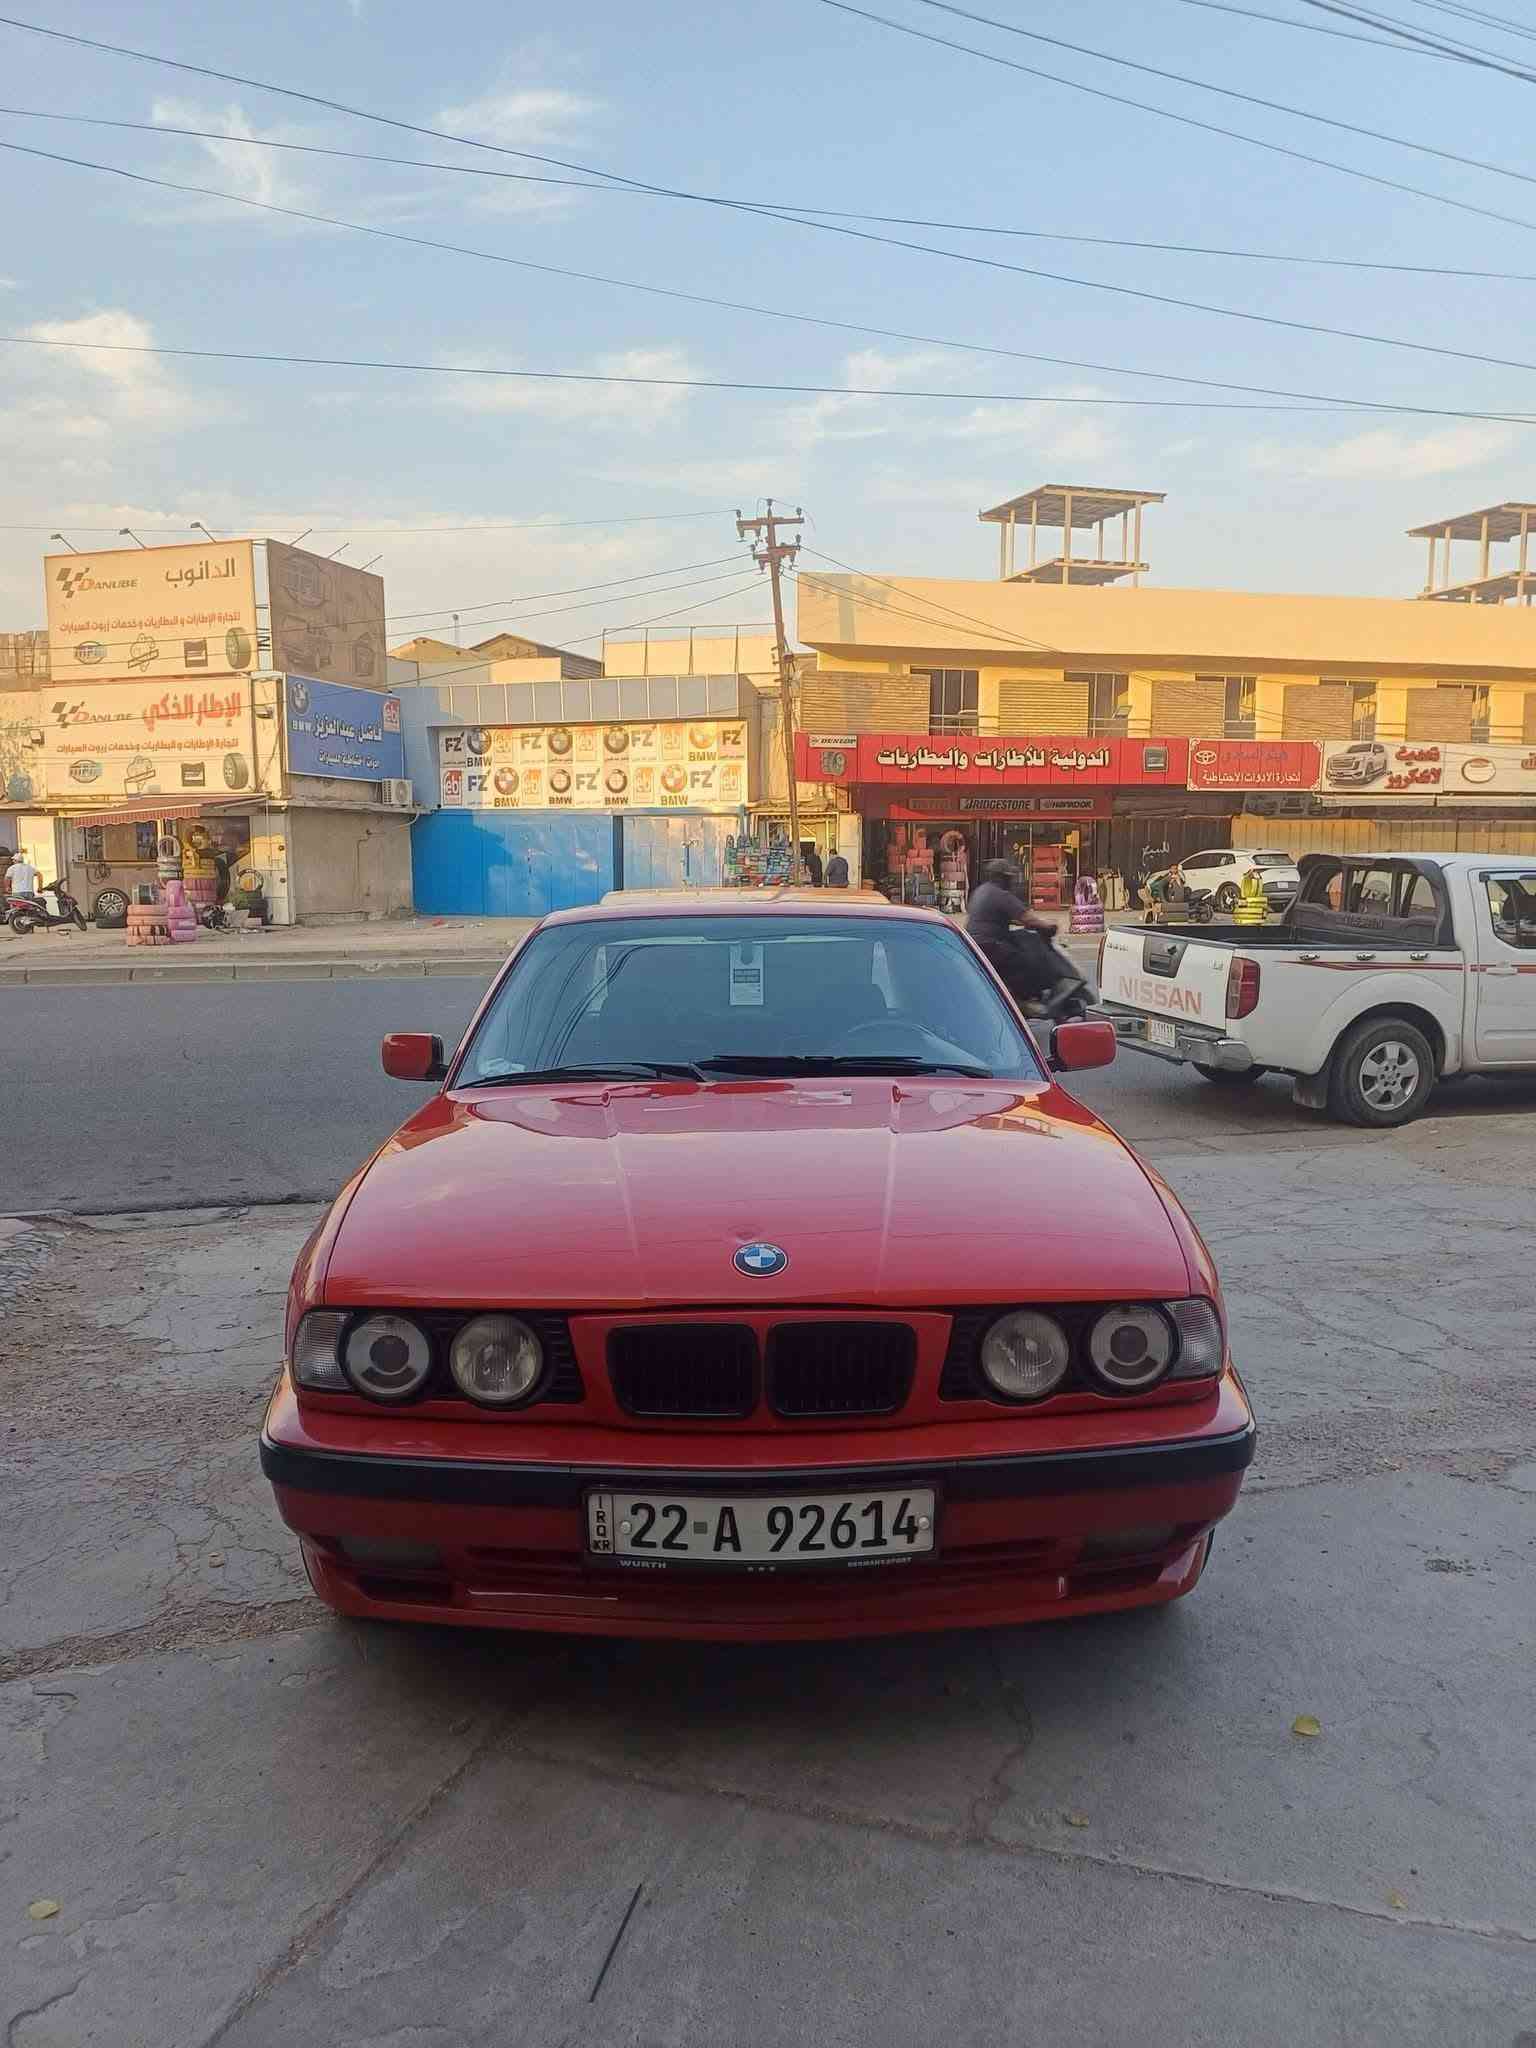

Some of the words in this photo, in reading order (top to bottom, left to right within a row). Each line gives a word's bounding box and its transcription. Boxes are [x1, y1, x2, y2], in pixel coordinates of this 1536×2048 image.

[166, 557, 236, 589] الدانوب
[78, 578, 139, 592] DANUBE
[72, 711, 134, 723] DANUBE
[143, 692, 194, 732] الذكي
[195, 692, 241, 727] الإطار
[292, 719, 312, 732] BMW
[445, 737, 463, 752] FZ
[521, 734, 542, 750] FZ
[631, 730, 653, 747] FZ
[722, 730, 742, 745] FZ
[466, 757, 493, 768] BMW
[688, 751, 717, 762] BMW
[877, 747, 969, 770] والبطاريات
[1050, 747, 1110, 770] الدولية
[467, 775, 489, 791] FZ
[576, 774, 597, 790] FZ
[690, 770, 713, 788] FZ
[494, 797, 520, 807] BMW
[549, 796, 573, 805] BMW
[604, 796, 629, 805] BMW
[661, 795, 689, 806] BMW
[965, 800, 1031, 810] BRIDGESTONE
[1142, 841, 1170, 867] للبيع
[1119, 976, 1202, 1015] NISSAN
[630, 1502, 689, 1551] 22
[713, 1506, 742, 1553] A
[767, 1498, 919, 1553] 92614
[593, 1540, 611, 1551] KR
